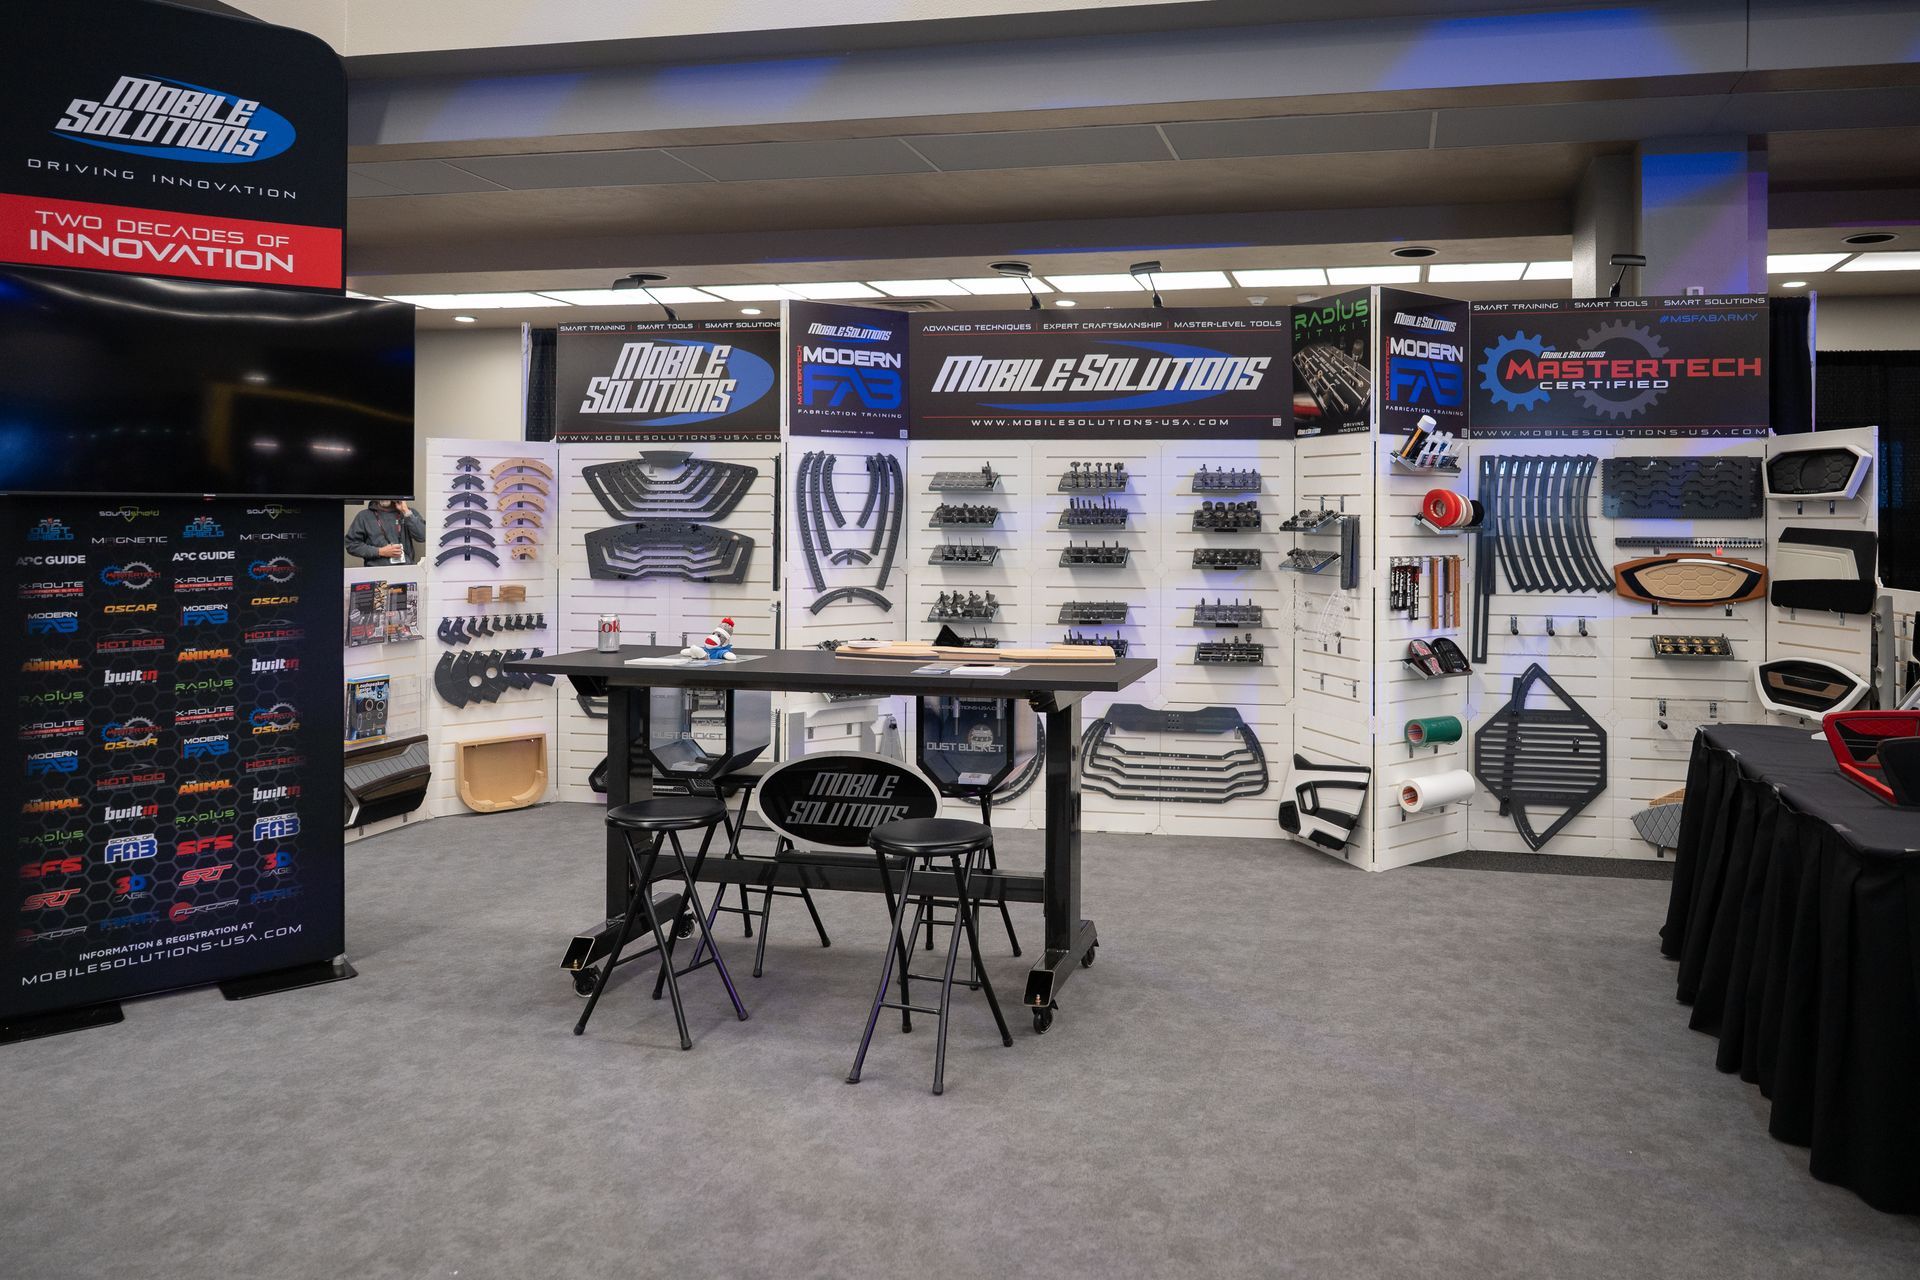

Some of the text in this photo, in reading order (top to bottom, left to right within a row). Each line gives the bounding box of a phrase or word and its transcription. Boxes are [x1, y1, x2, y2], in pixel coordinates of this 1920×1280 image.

[104, 75, 260, 126] MOBILE
[55, 99, 267, 157] SOLUTIONS
[28, 158, 297, 200] DRIVING INNOVATION
[35, 210, 290, 248] TWO DECADES OF
[30, 229, 294, 273] INNOVATION
[1295, 298, 1368, 331] RADIUS
[1659, 313, 1759, 324] #MSFABARMY
[923, 324, 971, 332] ADVANCED
[975, 323, 1031, 331] TECHNIQUES
[803, 346, 901, 368] MODERN
[1390, 336, 1464, 363] MODERN
[611, 342, 731, 380] MOBILE
[1506, 357, 1762, 380] MASTERTECH
[803, 364, 903, 409] FAB
[1390, 356, 1464, 407] FAB
[1539, 380, 1669, 390] CERTIFIED
[579, 376, 737, 414] SOLUTIONS
[797, 409, 902, 419] FABRICATION TRAINING
[1386, 405, 1464, 417] FABRICATION TRAINING
[971, 419, 1229, 427] WWW.MOBILESOLUTIONS-USA.COM
[1473, 428, 1766, 437] WWW.MOBILESOLUTIONS-USA.COM
[45, 555, 86, 565] GUIDE
[199, 551, 235, 561] GUIDE
[104, 603, 158, 614] OSCAR
[183, 604, 228, 612] MODERN
[251, 596, 299, 606] OSCAR
[28, 612, 78, 620] MODERN
[97, 641, 128, 650] HOT
[132, 638, 165, 647] ROD
[104, 669, 158, 684] builtin
[175, 678, 234, 690] RADIUS
[18, 690, 84, 703] RADIUS
[175, 705, 234, 717] X-ROUTE
[252, 723, 300, 735] OSCAR
[104, 738, 158, 751] OSCAR
[184, 734, 229, 745] MODERN
[27, 750, 78, 760] MODERN
[926, 742, 1004, 753] DUST BUCKET
[96, 776, 129, 787] HOT
[132, 773, 165, 782] ROD
[809, 772, 900, 799] MOBILE
[104, 804, 158, 821] builtin
[175, 809, 235, 825] RADIUS
[257, 816, 286, 824] SCHOOL
[785, 800, 910, 828] SOLUTIONS
[18, 829, 84, 844] RADIUS
[253, 817, 300, 841] FAB
[110, 837, 140, 845] SCHOOL
[176, 835, 234, 856] SFS
[105, 838, 158, 864] FAB
[263, 851, 292, 870] 3D
[20, 857, 84, 880] SFS
[115, 874, 148, 895] 3D
[79, 922, 254, 961] INFORMATION & REGISTRATION AT
[22, 924, 302, 986] MOBILESOLUTIONS-USA.COM
